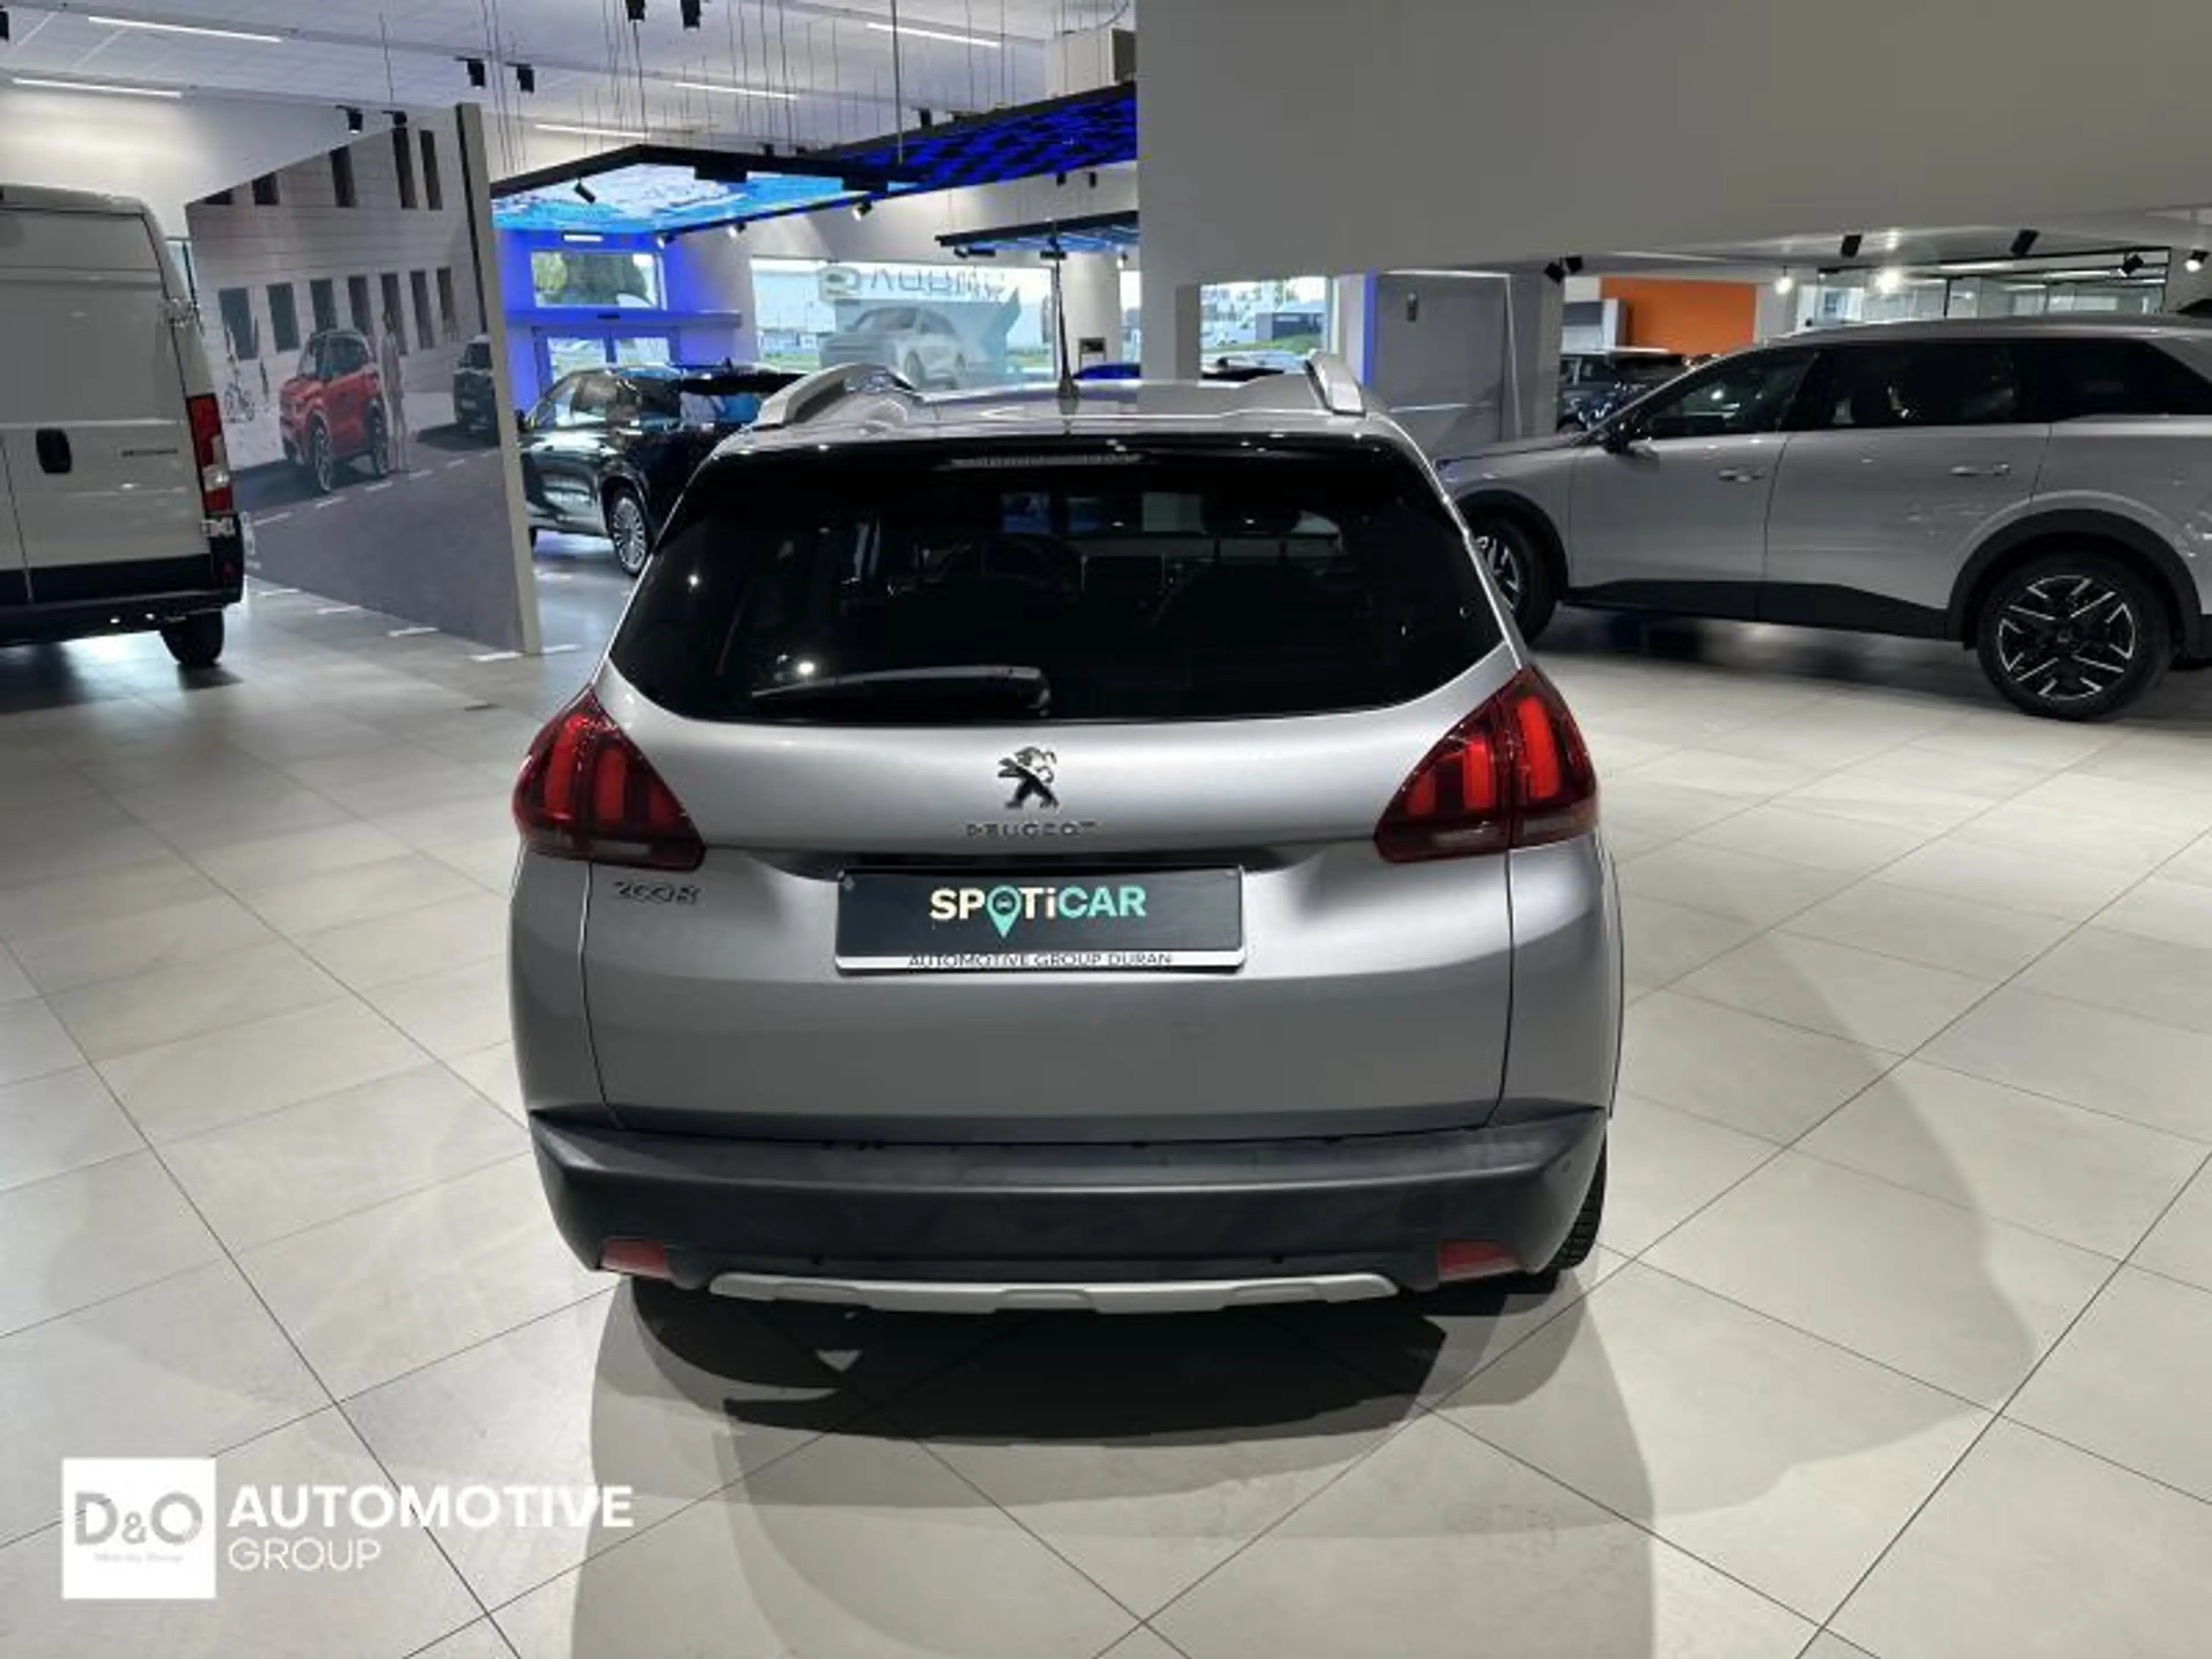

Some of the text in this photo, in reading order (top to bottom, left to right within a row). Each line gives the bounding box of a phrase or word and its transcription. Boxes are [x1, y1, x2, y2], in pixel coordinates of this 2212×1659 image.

[966, 820, 1095, 836] PEUGEOT
[909, 953, 1029, 969] AUTOMOTIVE
[1033, 952, 1101, 968] GROUP
